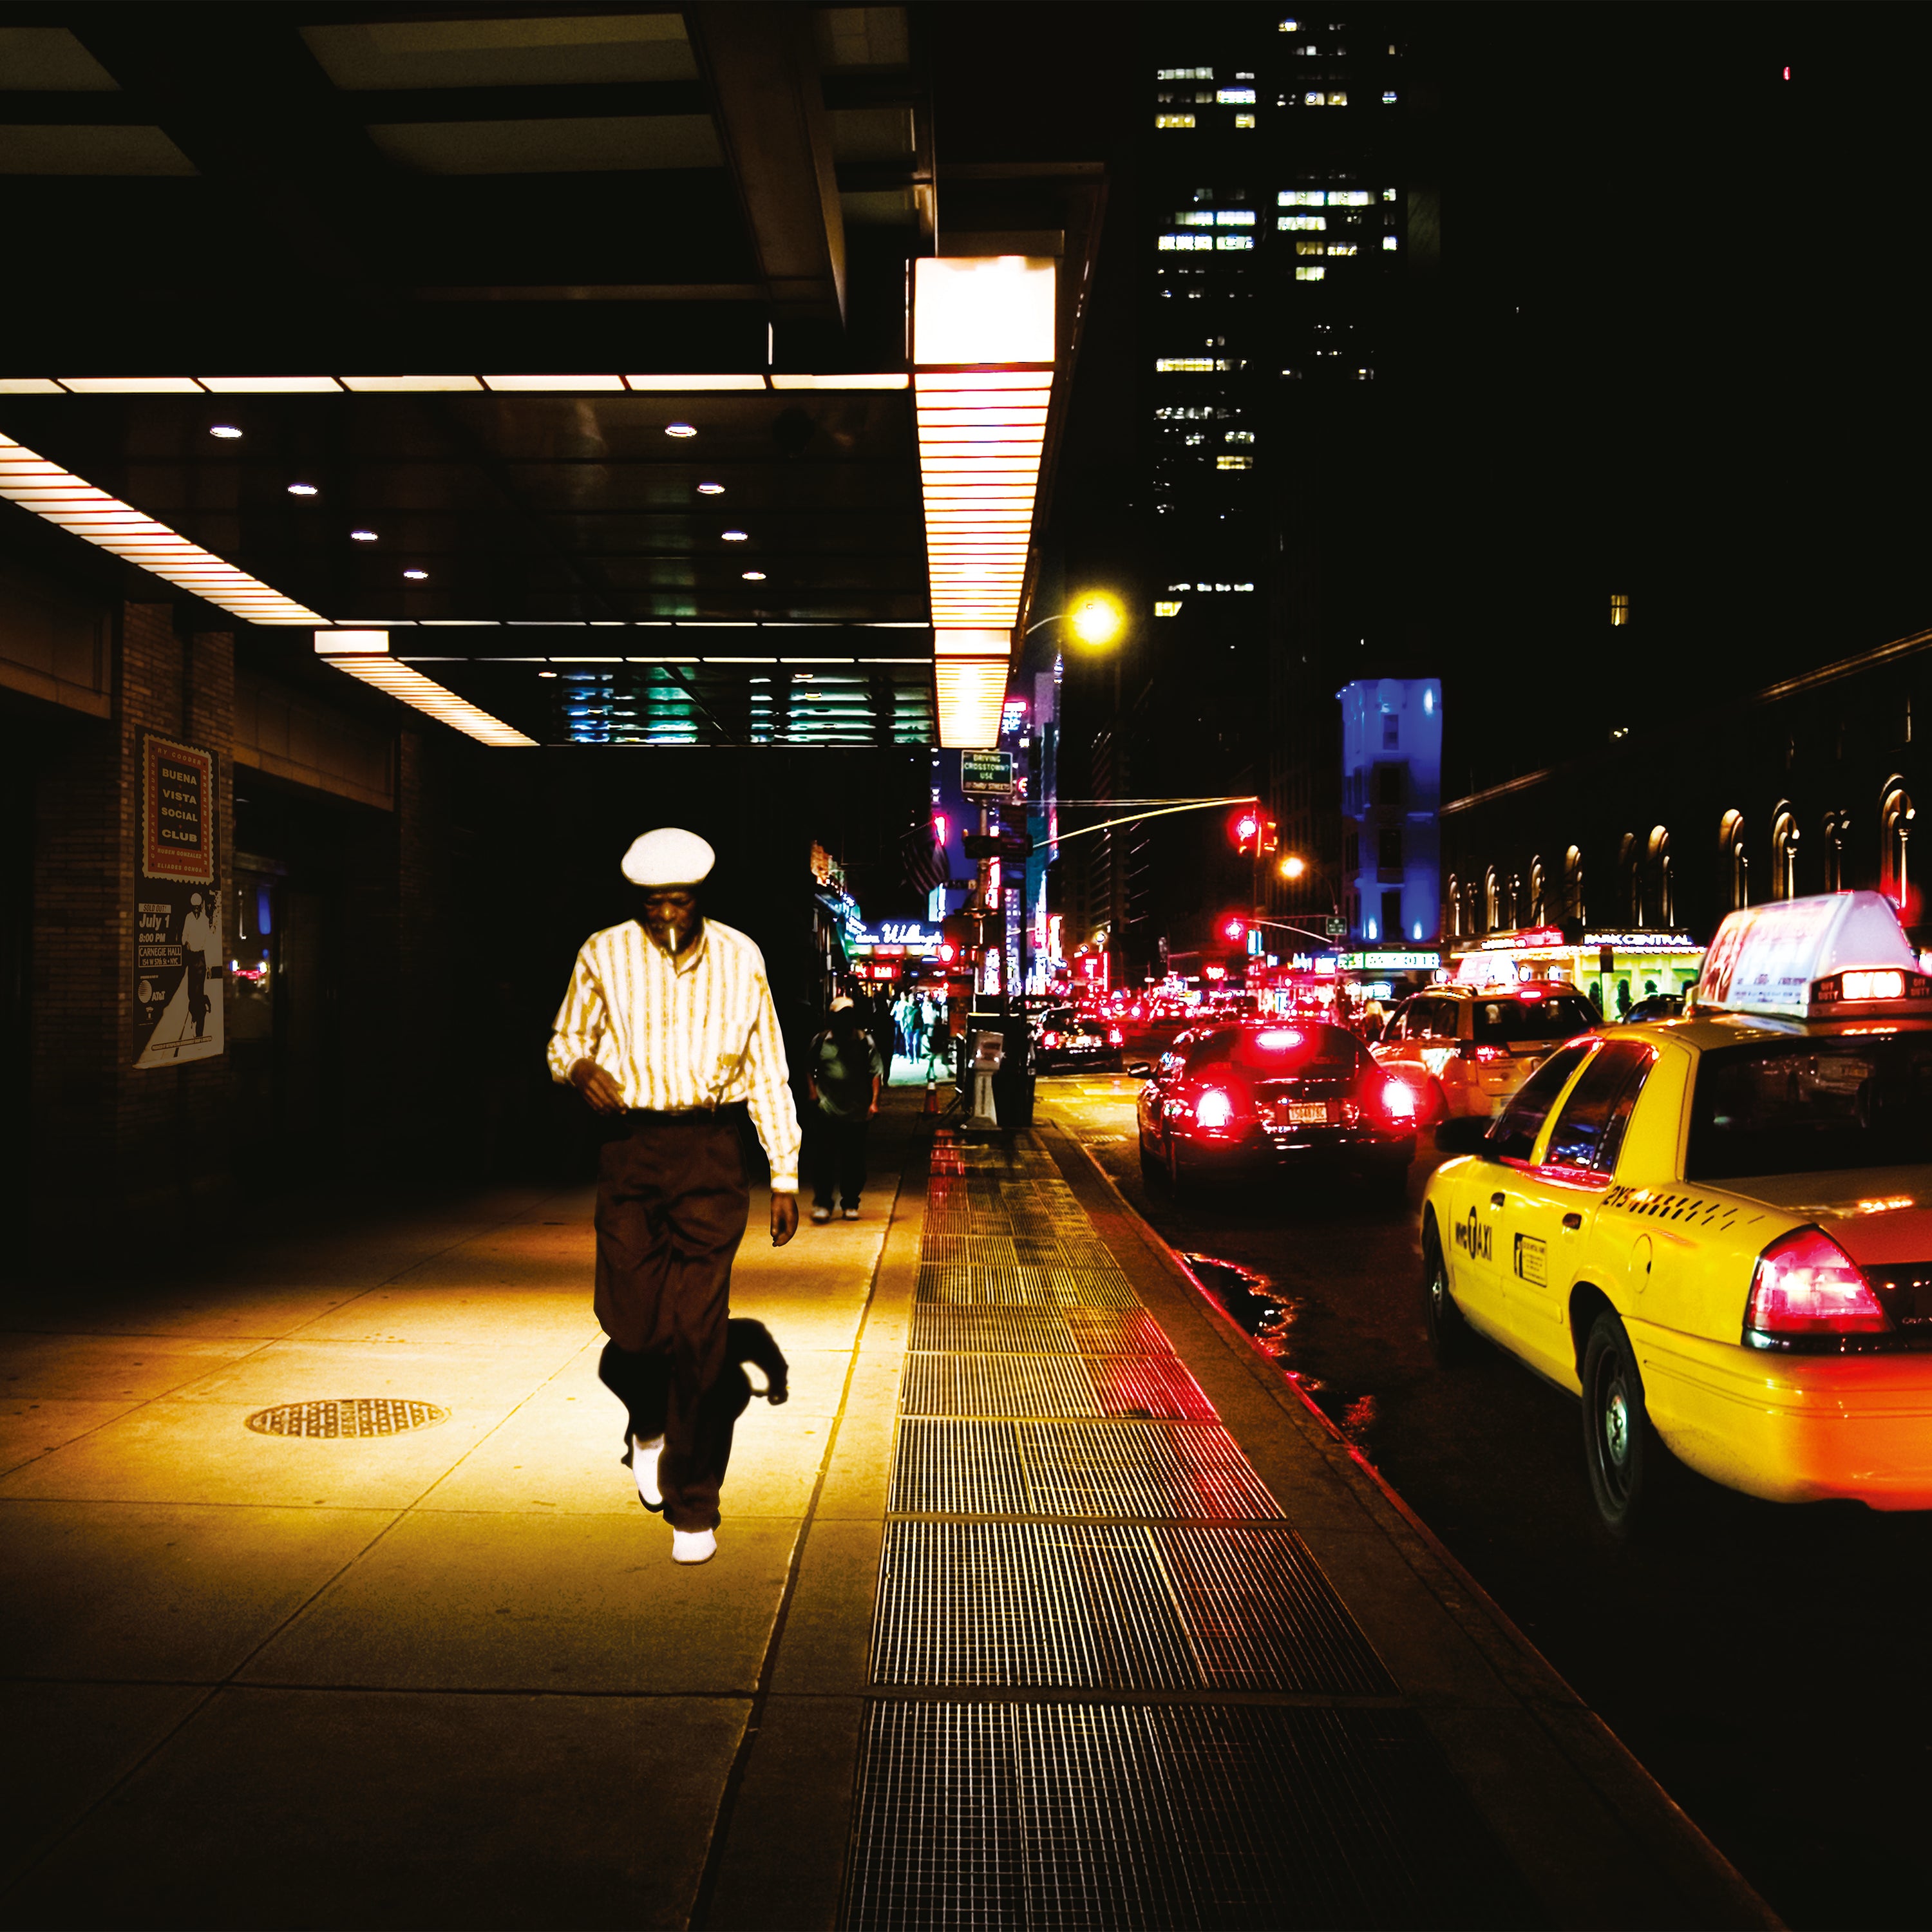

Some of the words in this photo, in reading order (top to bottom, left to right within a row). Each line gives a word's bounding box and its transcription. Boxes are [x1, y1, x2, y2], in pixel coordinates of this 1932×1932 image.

[171, 752, 202, 765] COODER
[973, 754, 1000, 762] DRIVING
[162, 768, 197, 786] BUENA
[162, 788, 197, 805] VISTA
[161, 807, 198, 822] SOCIAL
[161, 829, 198, 843] CLUB
[176, 850, 202, 859] GONZALEZ
[139, 914, 162, 931] July
[165, 914, 170, 928] 1
[138, 933, 154, 943] 8:00
[155, 933, 166, 943] PM
[1584, 934, 1623, 945] PARK
[1622, 934, 1693, 945] CENTRAL
[139, 947, 167, 957] CARNEGIE
[167, 947, 181, 956] HALL
[151, 991, 166, 1001] AT&T
